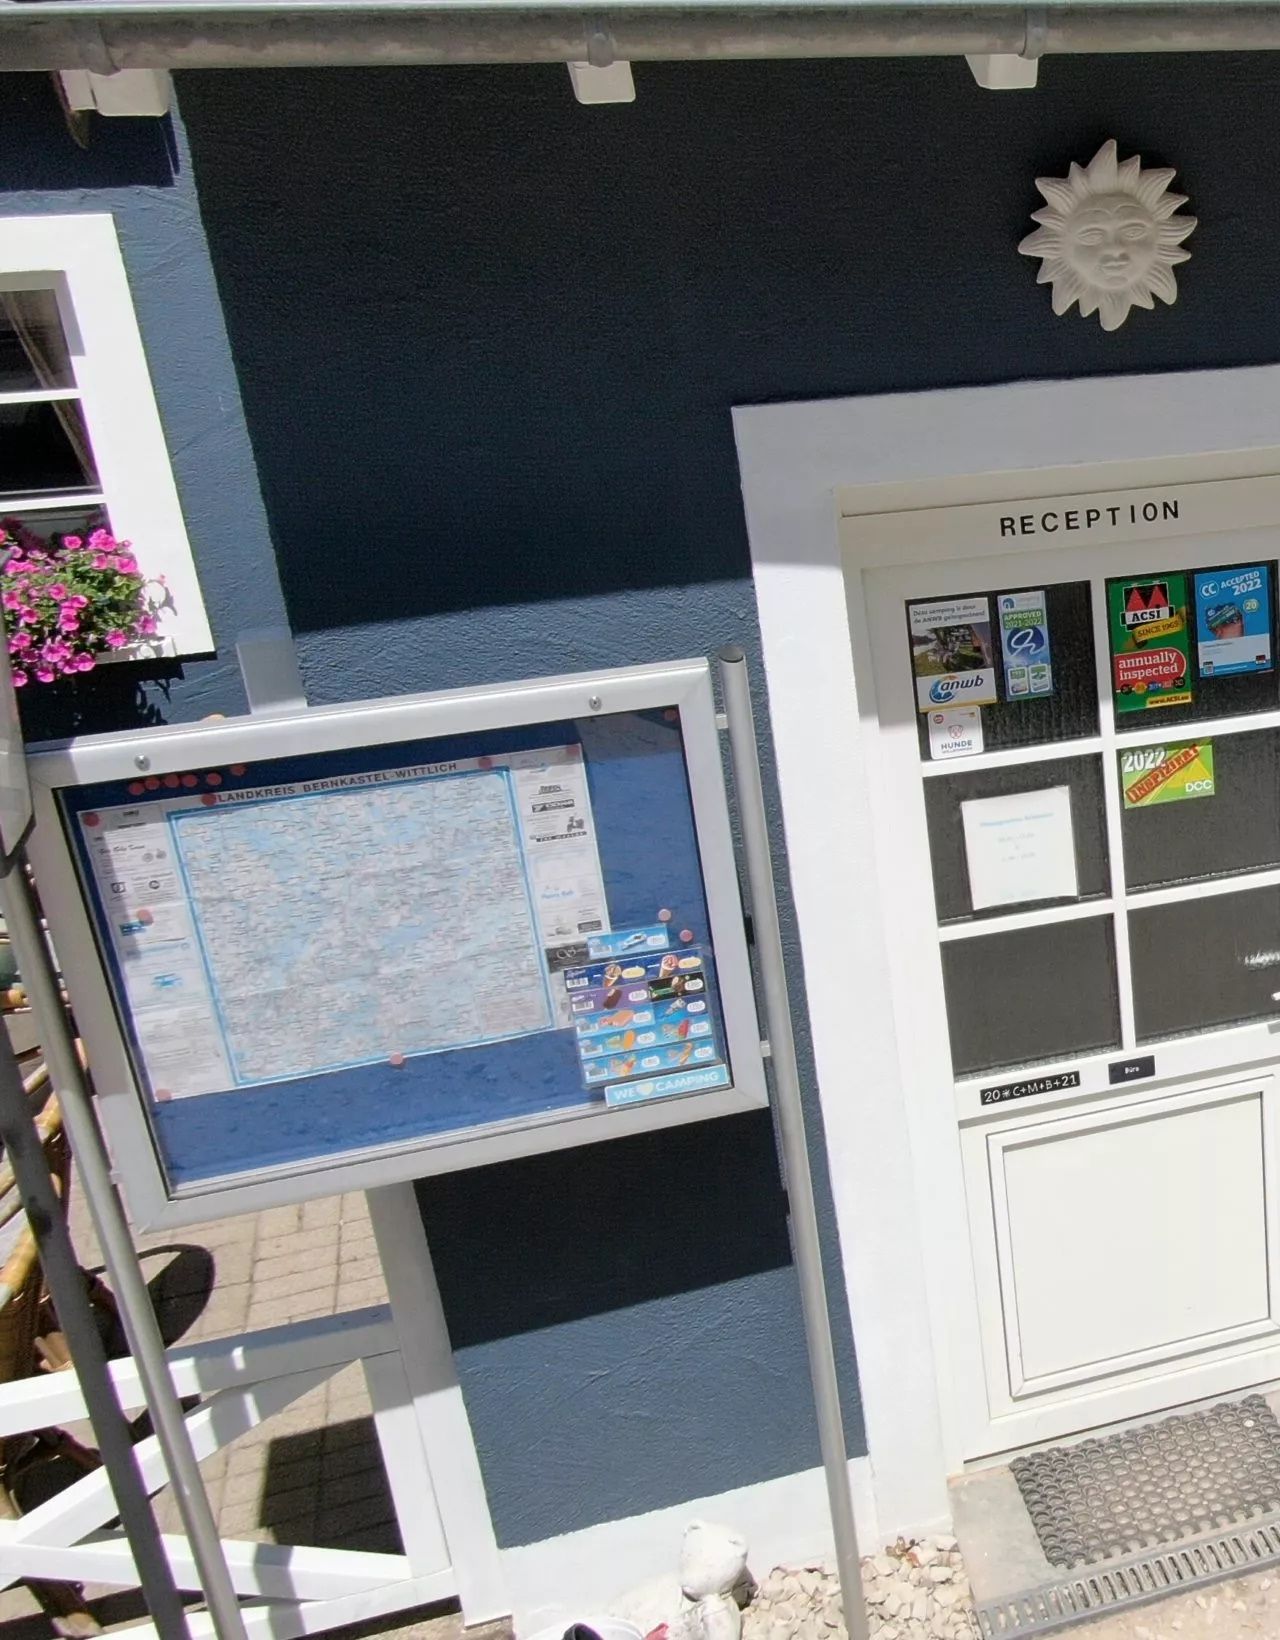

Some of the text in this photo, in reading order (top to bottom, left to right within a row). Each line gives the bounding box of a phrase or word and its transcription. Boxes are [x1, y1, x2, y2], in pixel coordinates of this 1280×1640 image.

[1000, 500, 1179, 536] RECEPTION
[1221, 571, 1260, 588] ACCEPTED
[1232, 579, 1262, 596] 2022
[1201, 582, 1217, 597] CC
[1004, 610, 1042, 620] APPROVED
[1131, 610, 1161, 622] ACSI
[1005, 618, 1042, 629] 2021-2022
[1138, 627, 1161, 638] SINCE
[1118, 651, 1177, 669] annually
[1119, 663, 1179, 680] inspected
[940, 675, 984, 691] anwb
[941, 740, 973, 750] HUNDE
[1121, 747, 1166, 773] 2022
[217, 763, 457, 803] LANDKREIS BERNKASTEL-WITTLICH
[1185, 780, 1213, 792] DCC
[1124, 1066, 1140, 1074] Büro
[614, 1072, 719, 1100] WE CAMPING
